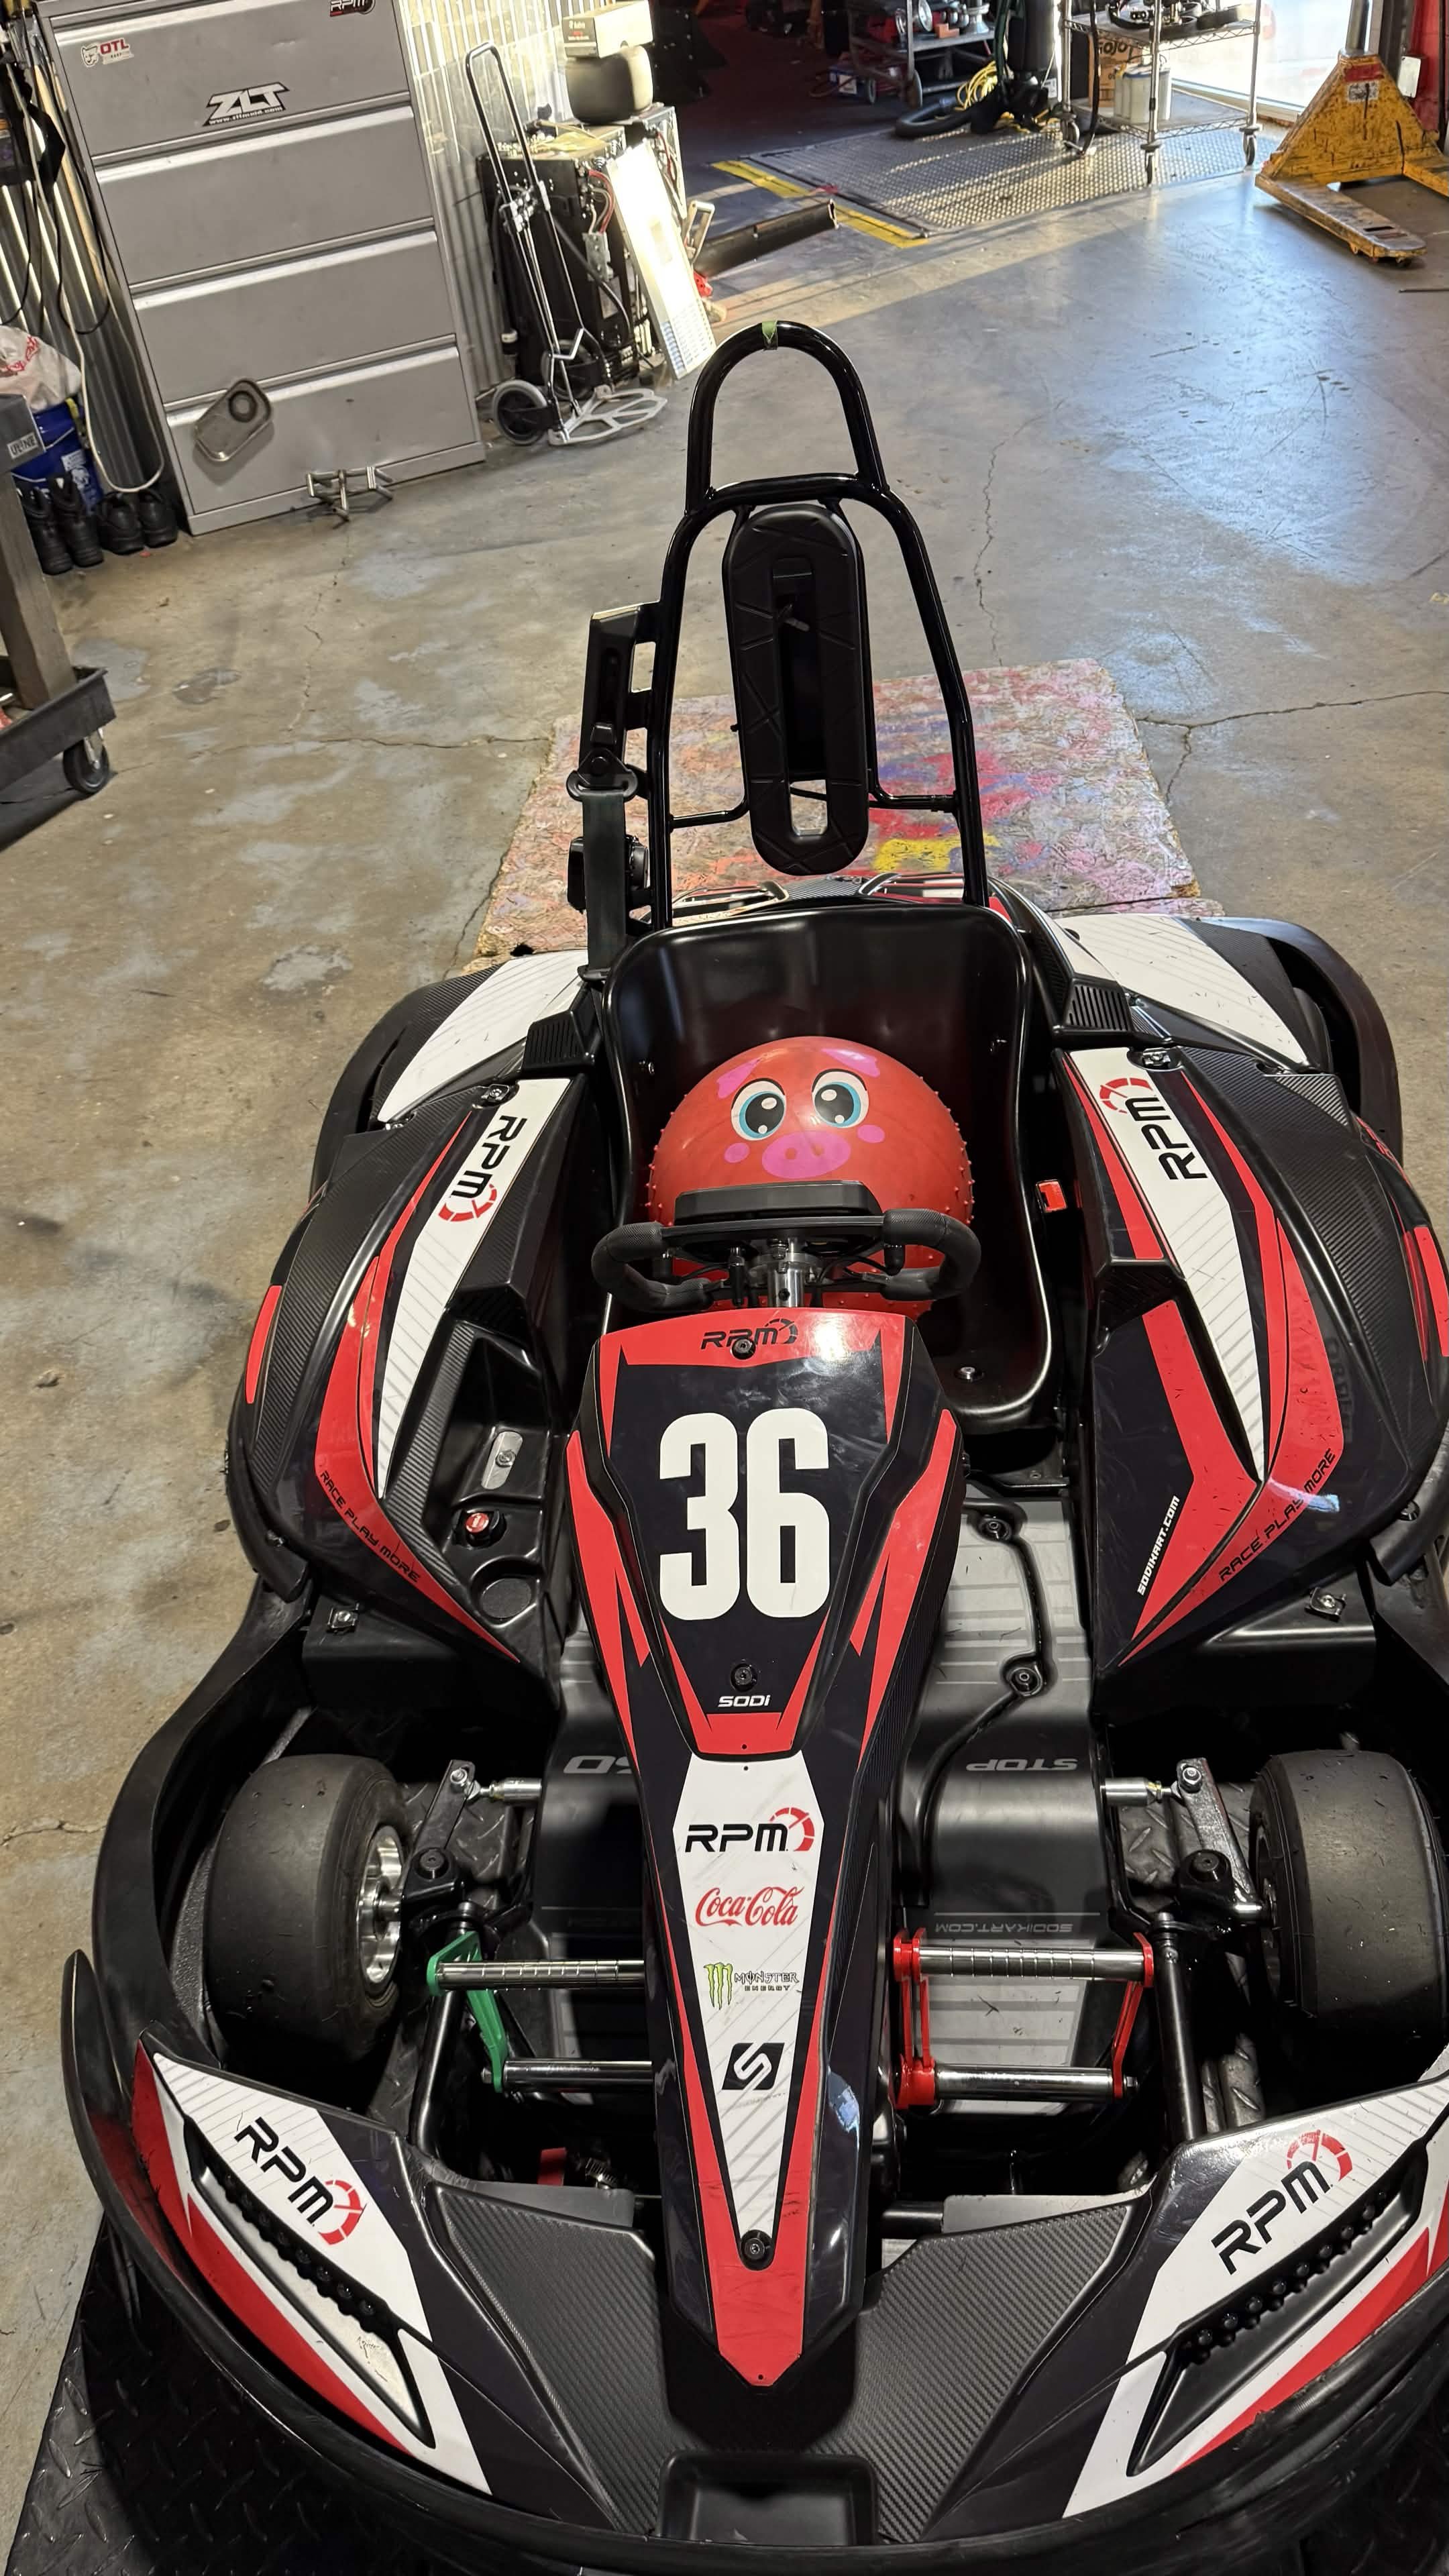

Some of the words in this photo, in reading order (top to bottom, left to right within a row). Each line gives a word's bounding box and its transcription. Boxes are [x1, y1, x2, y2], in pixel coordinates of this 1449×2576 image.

[100, 39, 129, 54] OTL
[209, 83, 286, 120] ZLT
[449, 1115, 528, 1199] RPM
[1125, 1097, 1208, 1180] RPM
[701, 1327, 778, 1350] RPM
[320, 1470, 346, 1509] RACE
[344, 1507, 379, 1546] PLAY
[380, 1545, 420, 1582] MORE
[659, 1407, 830, 1621] 36
[1218, 1536, 1263, 1582] RACE
[1264, 1497, 1303, 1540] PLAY
[1303, 1448, 1336, 1493] MORE
[1136, 1495, 1180, 1596] SODIKART.COM
[966, 1758, 1078, 1771] STOP
[684, 1823, 788, 1853] RPM
[695, 1886, 804, 1927] Coca-Cola
[935, 1923, 1074, 1933] SODIKART.COM
[734, 1970, 800, 1984] MONSTER
[233, 2116, 333, 2225] RPM
[1211, 2161, 1332, 2275] RPM
